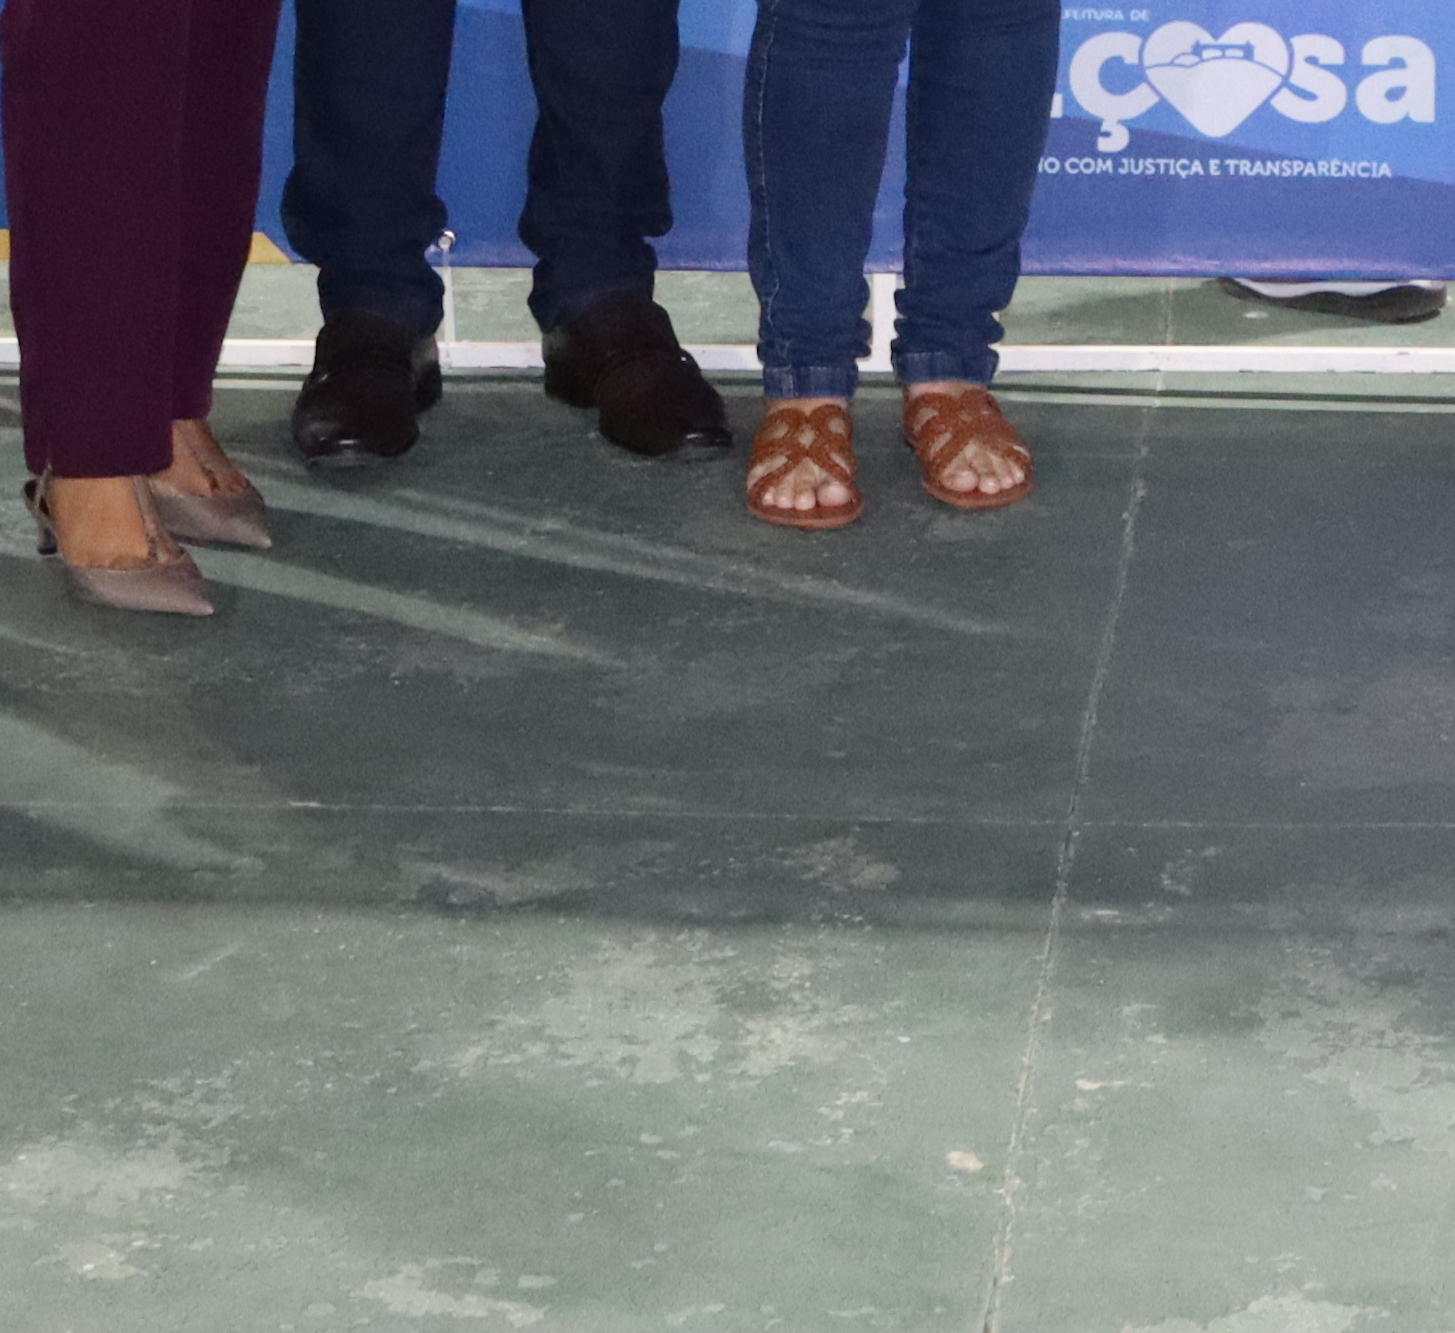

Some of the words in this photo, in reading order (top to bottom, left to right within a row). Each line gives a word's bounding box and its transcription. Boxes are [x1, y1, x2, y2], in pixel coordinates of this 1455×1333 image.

[1129, 8, 1151, 21] DE
[1064, 156, 1113, 175] COM
[1117, 157, 1205, 180] JUSTIÇA
[1208, 159, 1222, 176] E
[1225, 157, 1393, 178] TRANSPARÊNCIA
